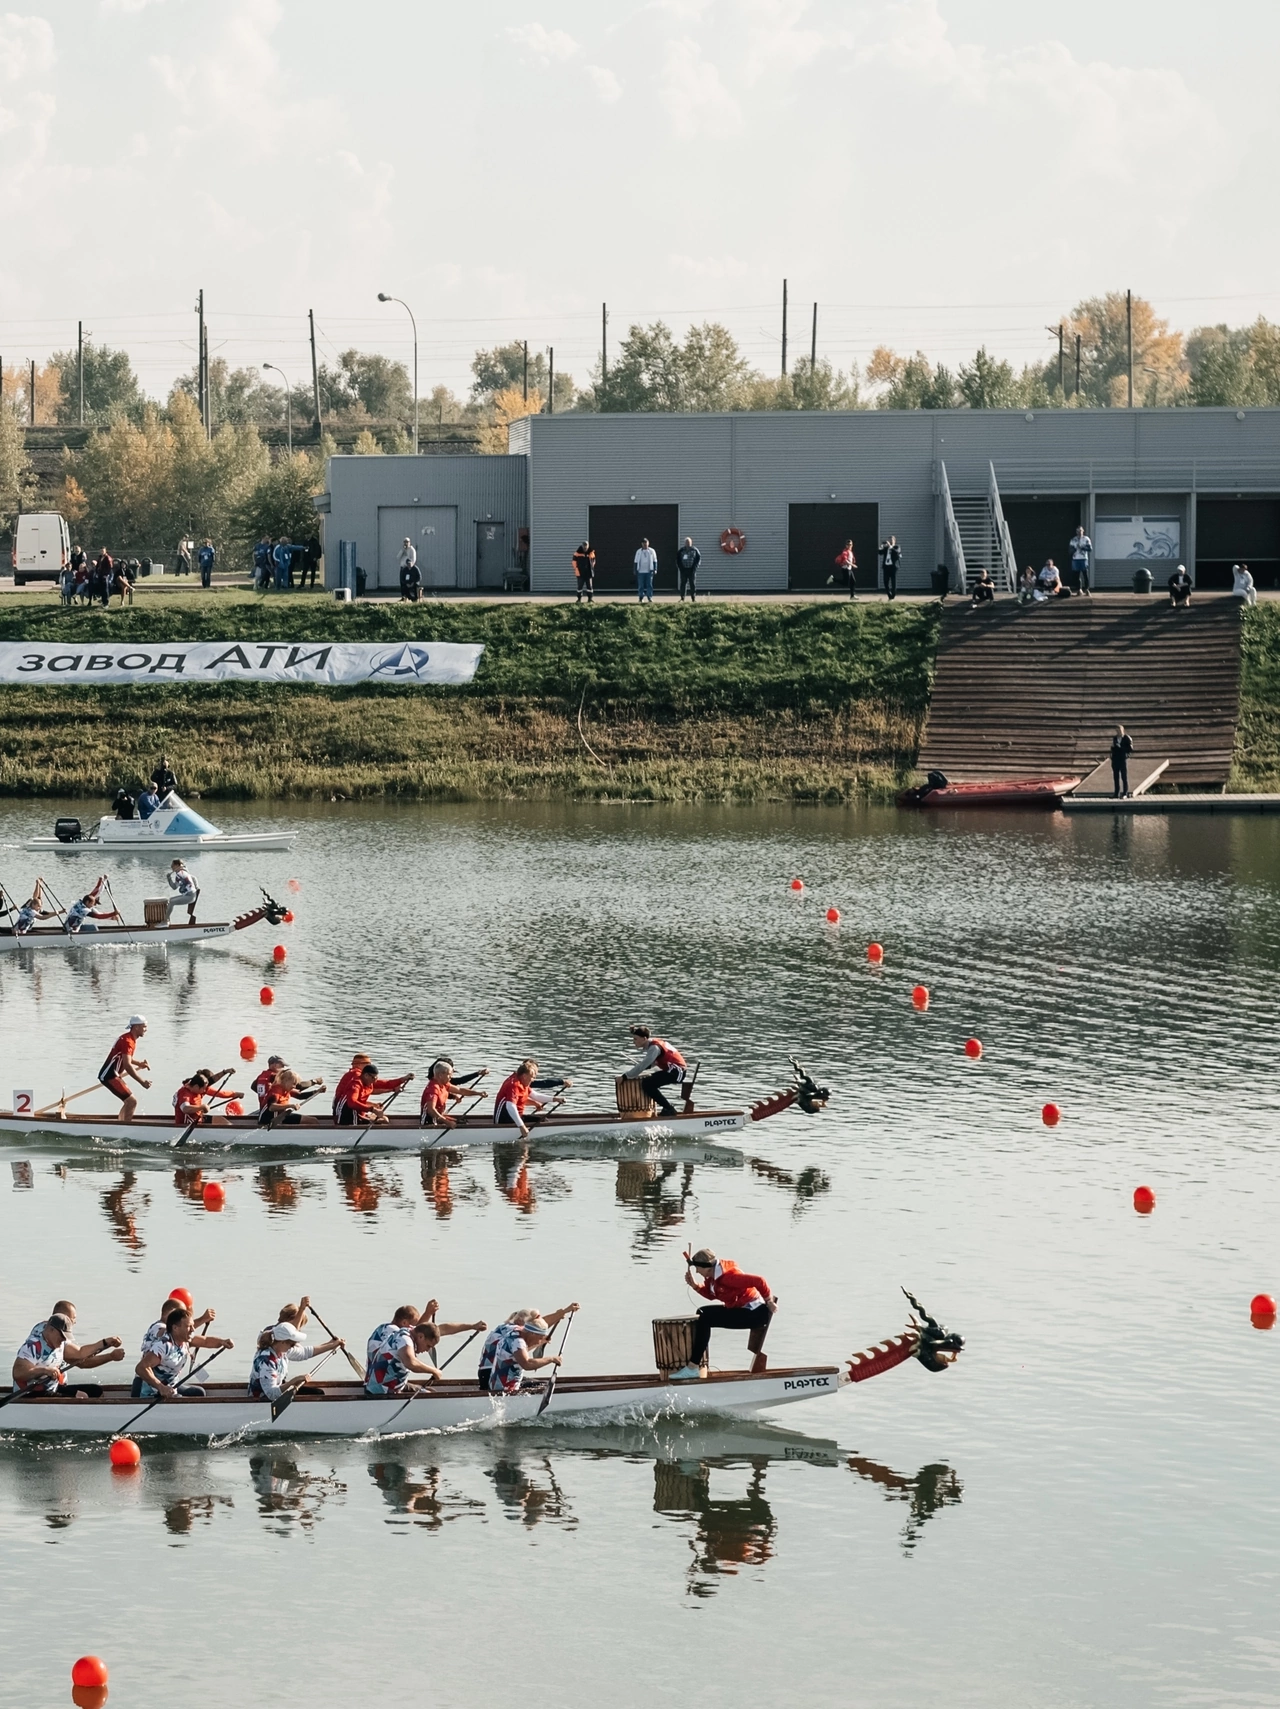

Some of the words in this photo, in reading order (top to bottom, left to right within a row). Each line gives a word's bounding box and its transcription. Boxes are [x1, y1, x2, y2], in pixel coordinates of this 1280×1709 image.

[16, 653, 186, 673] завод
[204, 644, 333, 670] АТИ
[16, 1093, 31, 1112] 2
[783, 1376, 830, 1390] PLASTEX
